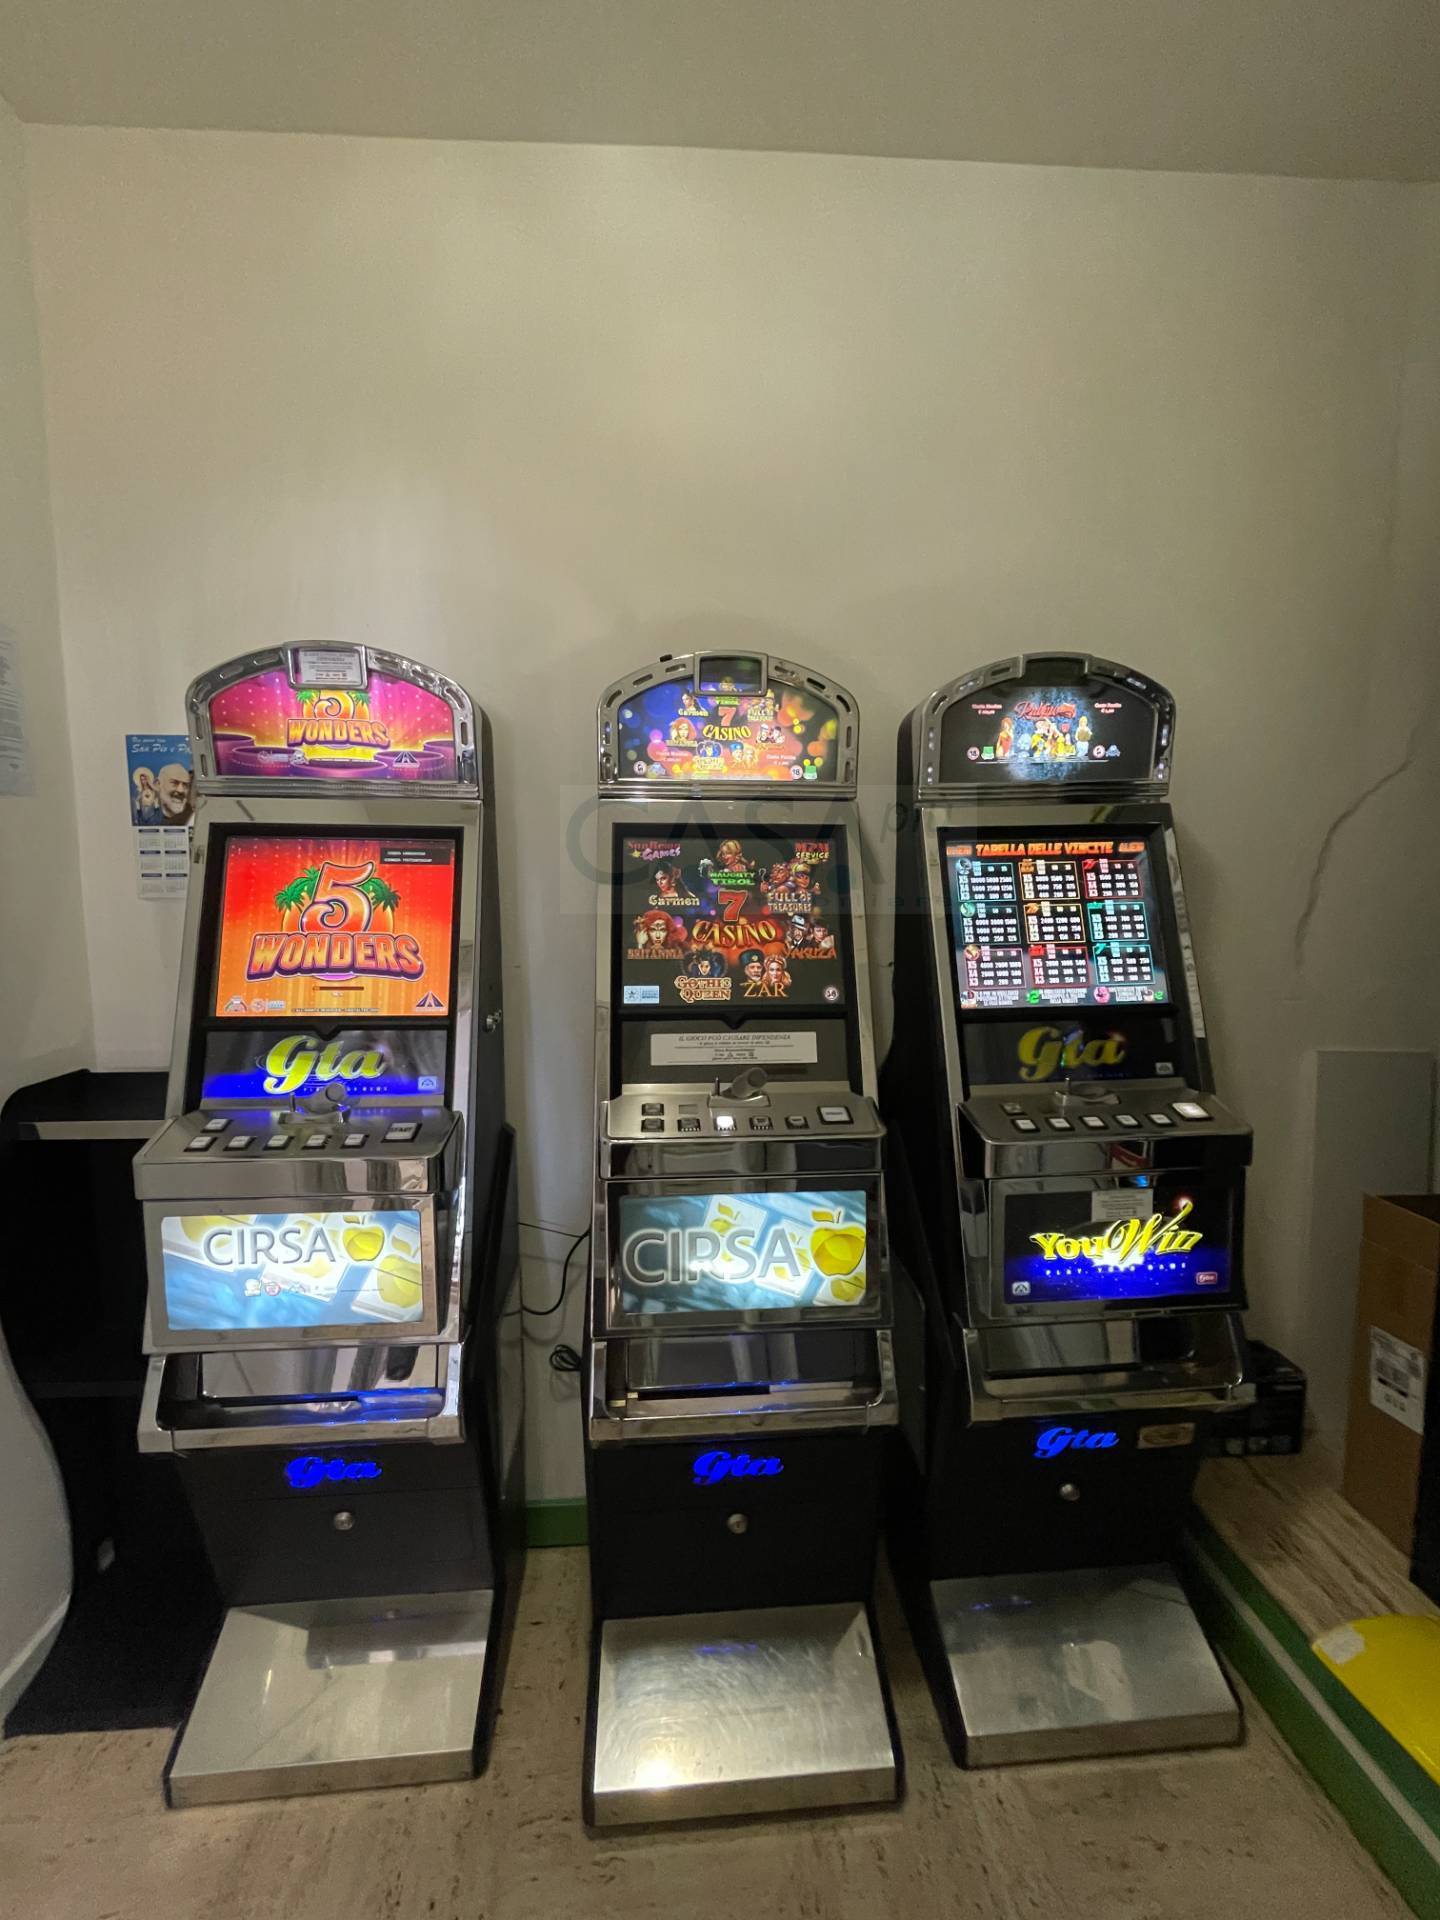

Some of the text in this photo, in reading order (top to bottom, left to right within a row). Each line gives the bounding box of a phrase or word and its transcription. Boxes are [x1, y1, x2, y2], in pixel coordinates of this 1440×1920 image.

[718, 707, 736, 727] 7
[287, 718, 391, 748] WONDERS
[702, 724, 752, 741] CASINO
[975, 843, 1025, 857] TABELLA
[1028, 842, 1062, 855] DELLE
[1064, 841, 1114, 854] VINCITE
[710, 878, 755, 886] TIROL
[300, 861, 375, 933] 5
[648, 895, 700, 906] Carmen
[718, 890, 748, 922] 7
[767, 892, 796, 902] FULL
[692, 920, 777, 949] CASINO
[246, 932, 425, 982] WONDERS
[680, 988, 731, 1003] QUEEN
[743, 983, 789, 998] ZAR
[202, 1226, 337, 1266] CIRSA
[622, 1227, 802, 1287] CIRSA
